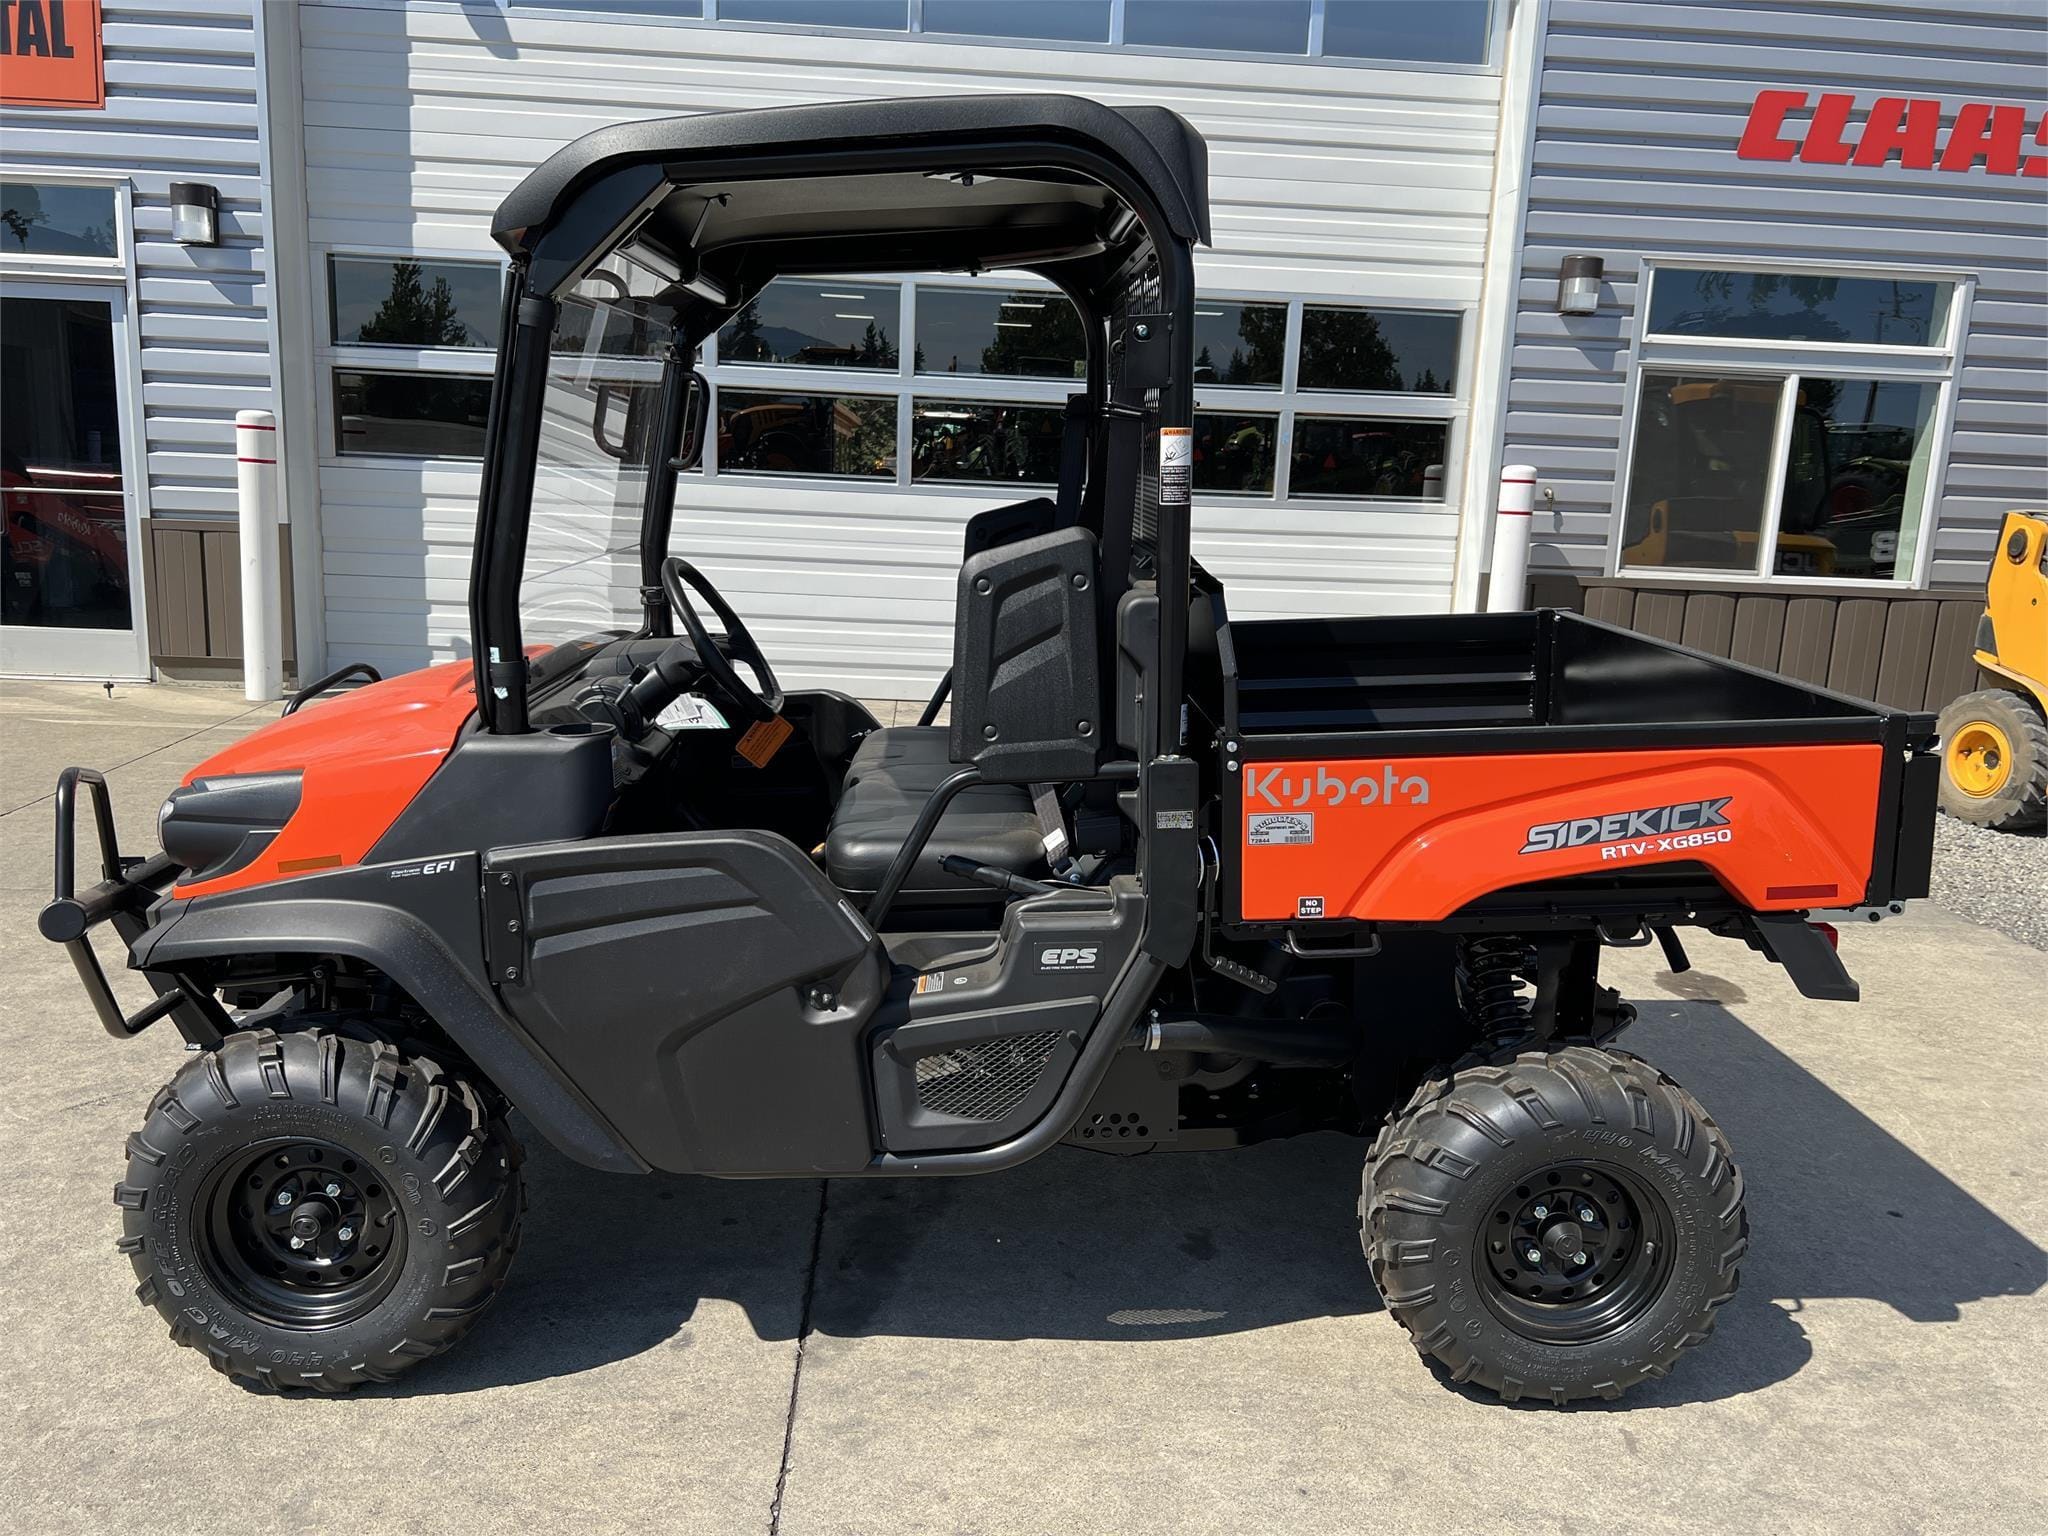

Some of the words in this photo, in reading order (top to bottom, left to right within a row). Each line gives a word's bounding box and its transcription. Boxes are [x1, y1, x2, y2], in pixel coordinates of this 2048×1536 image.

[1247, 765, 1429, 807] Kubota
[1518, 796, 1733, 855] SIDEKICK
[1600, 829, 1733, 860] RTV-XG850
[423, 860, 456, 875] EFI
[1305, 899, 1318, 907] NO
[1041, 947, 1098, 965] EPS
[1582, 1128, 1634, 1149] 440
[269, 1349, 323, 1367] 440
